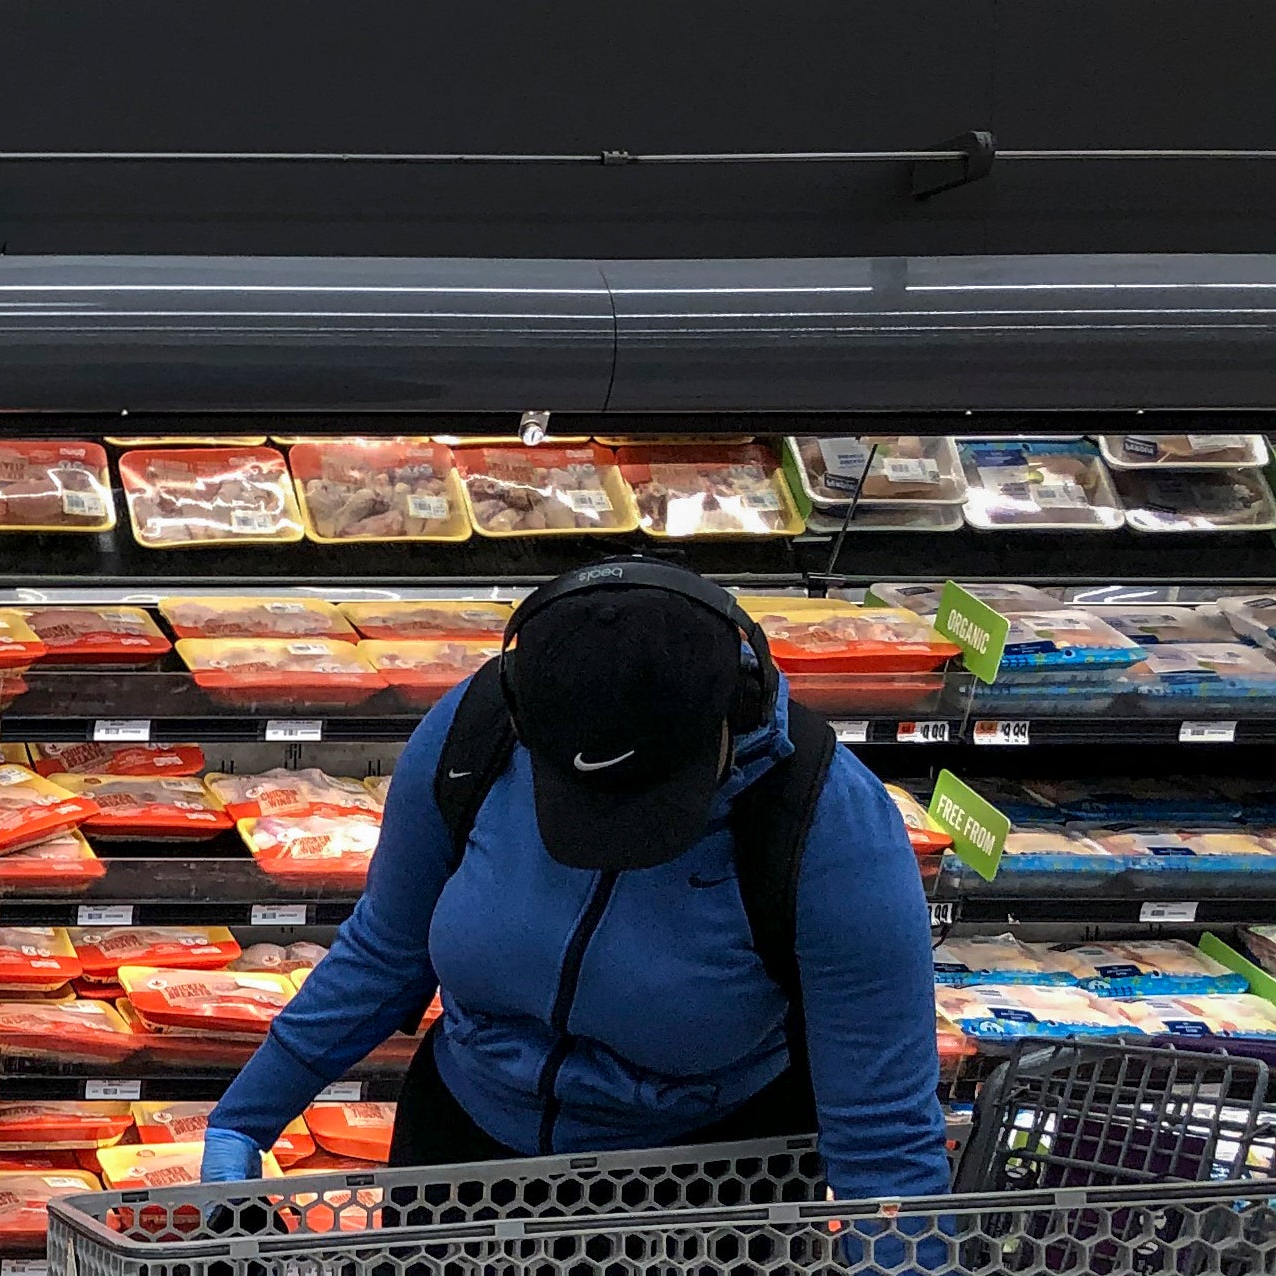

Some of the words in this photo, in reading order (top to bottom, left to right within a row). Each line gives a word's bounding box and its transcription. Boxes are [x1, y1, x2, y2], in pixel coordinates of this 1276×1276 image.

[578, 567, 623, 582] beats
[947, 608, 990, 655] ORGANIC
[936, 793, 966, 832] FREE
[963, 816, 996, 857] FROM
